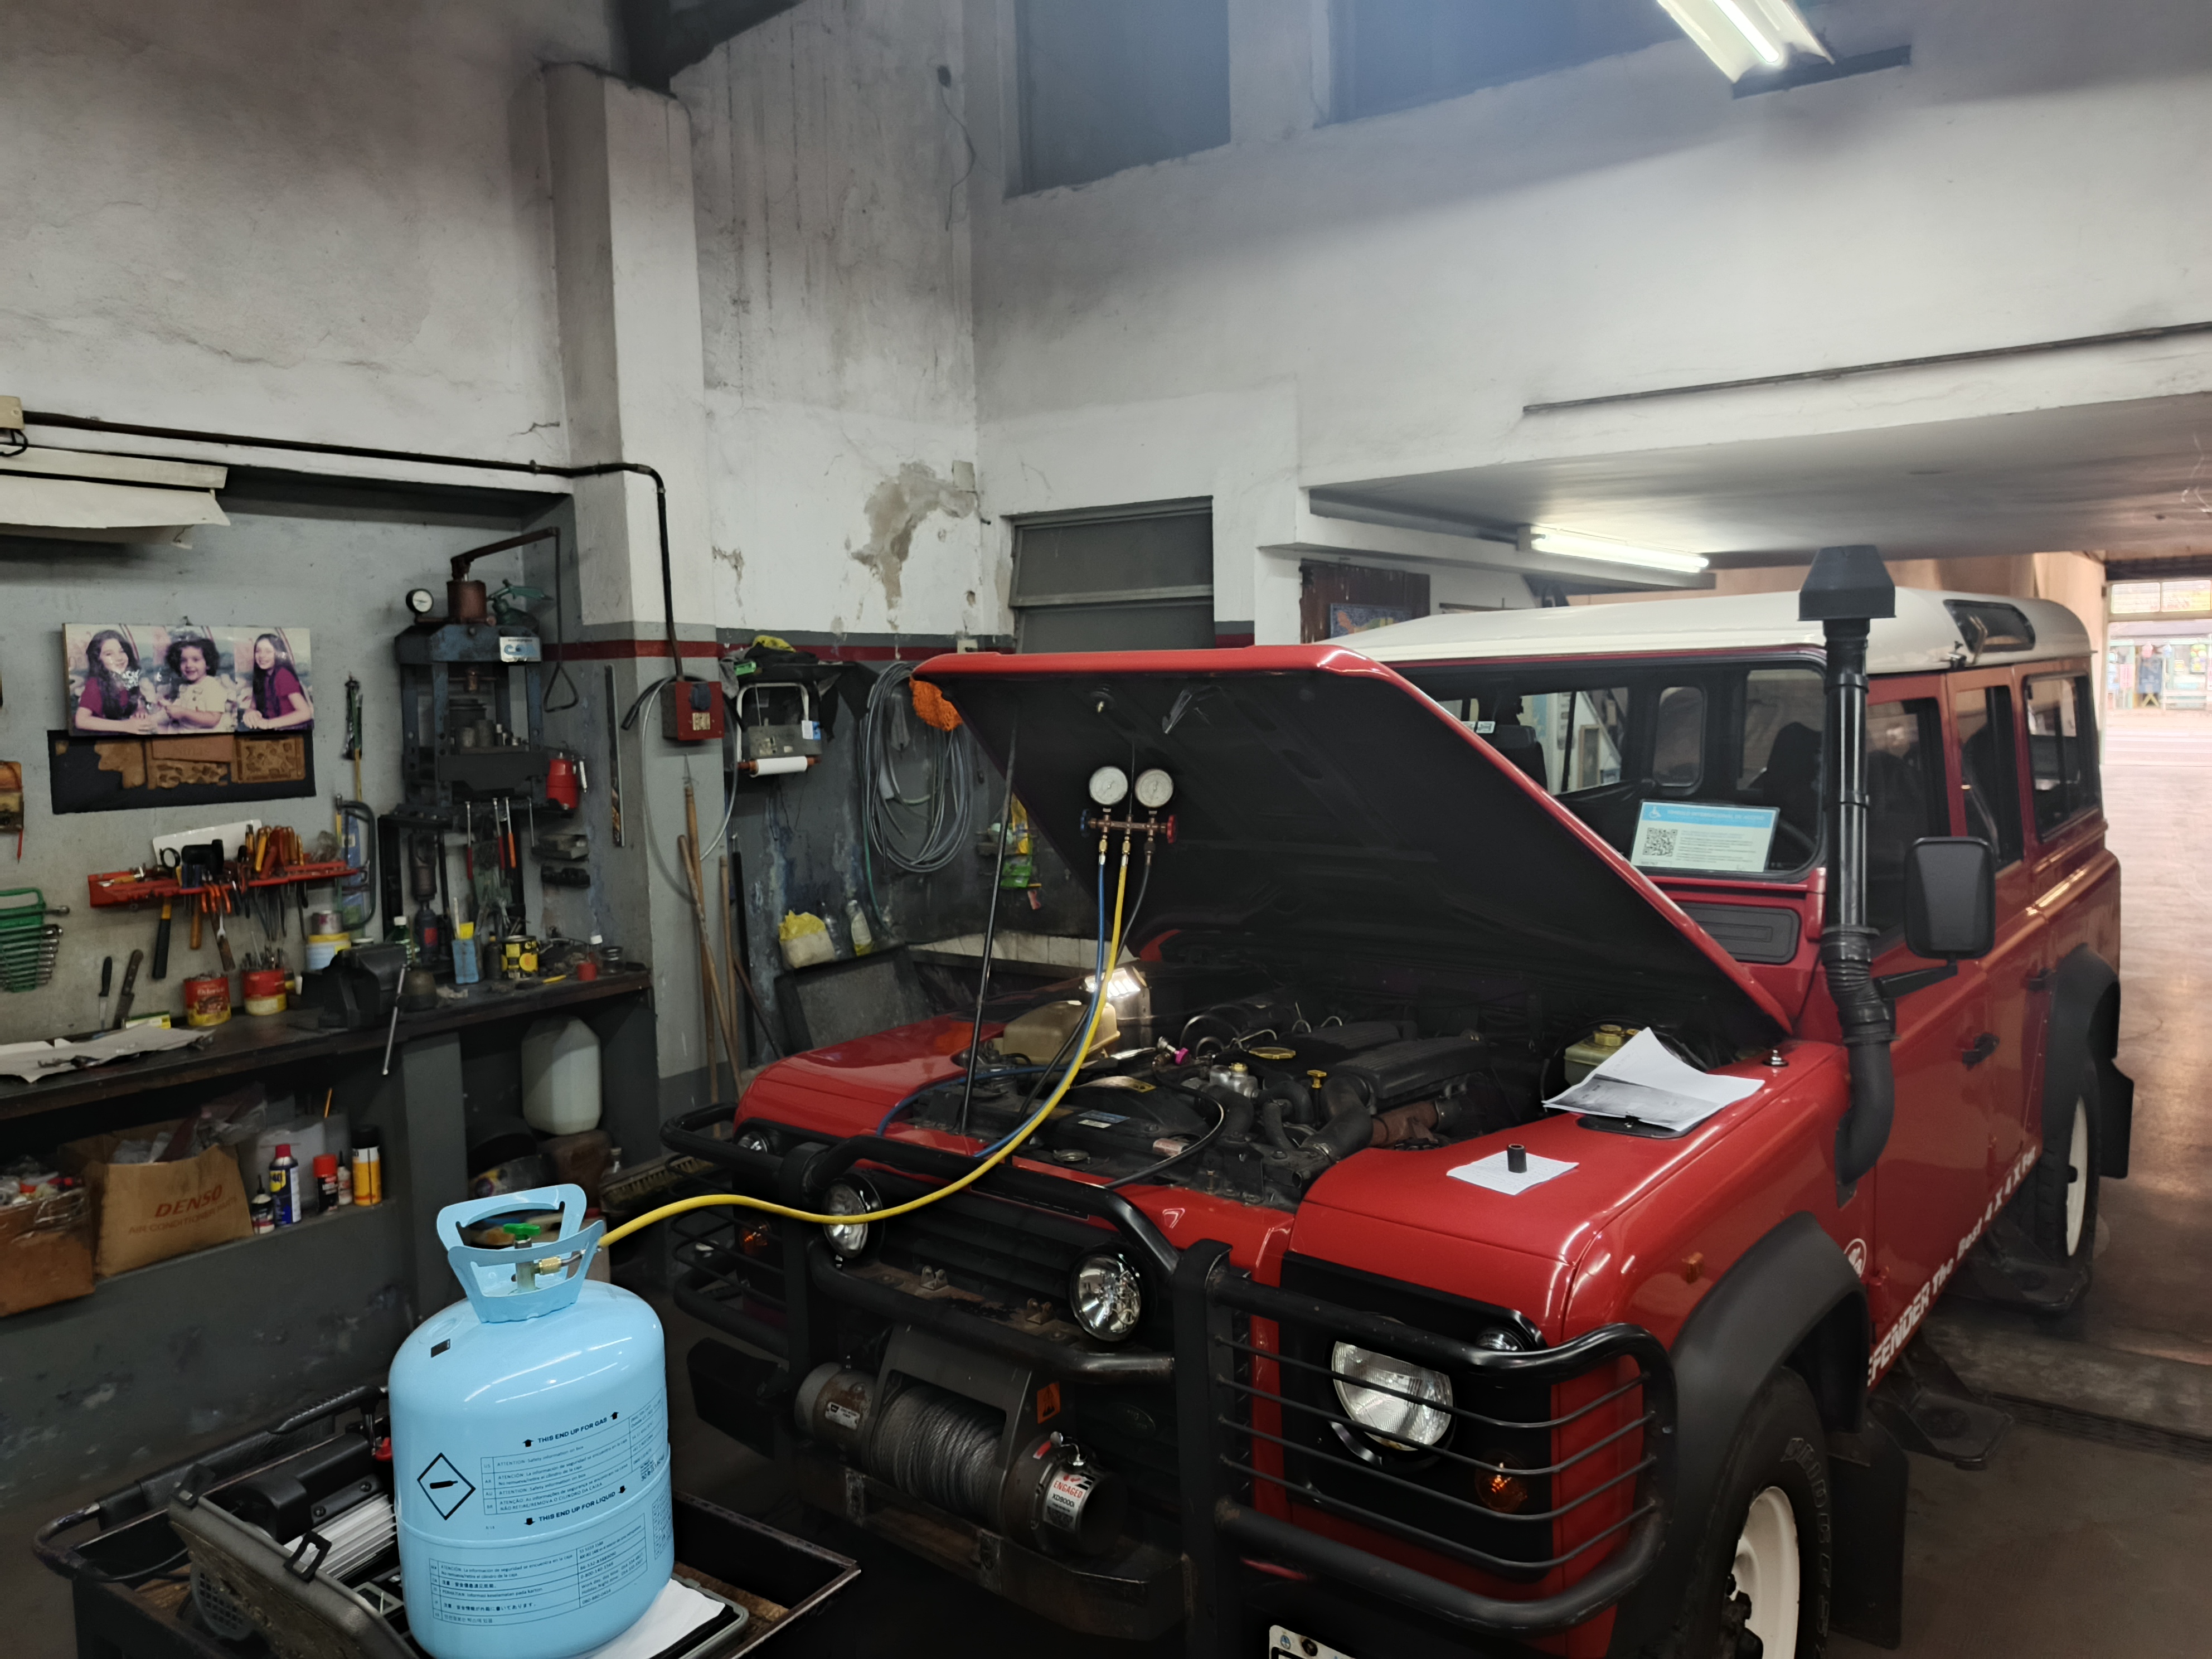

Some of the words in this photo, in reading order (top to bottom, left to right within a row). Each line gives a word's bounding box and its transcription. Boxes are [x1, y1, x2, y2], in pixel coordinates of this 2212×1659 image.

[154, 1184, 222, 1217] DENSO
[537, 1435, 554, 1443] THIS
[581, 1423, 593, 1432] FOR
[595, 1417, 607, 1427] GAS
[543, 1451, 569, 1459] information
[545, 1479, 571, 1487] information
[1054, 1481, 1083, 1498] ENGAGED
[539, 1513, 555, 1521] THIS
[581, 1501, 595, 1510] FOR
[596, 1492, 616, 1504] LIQUID
